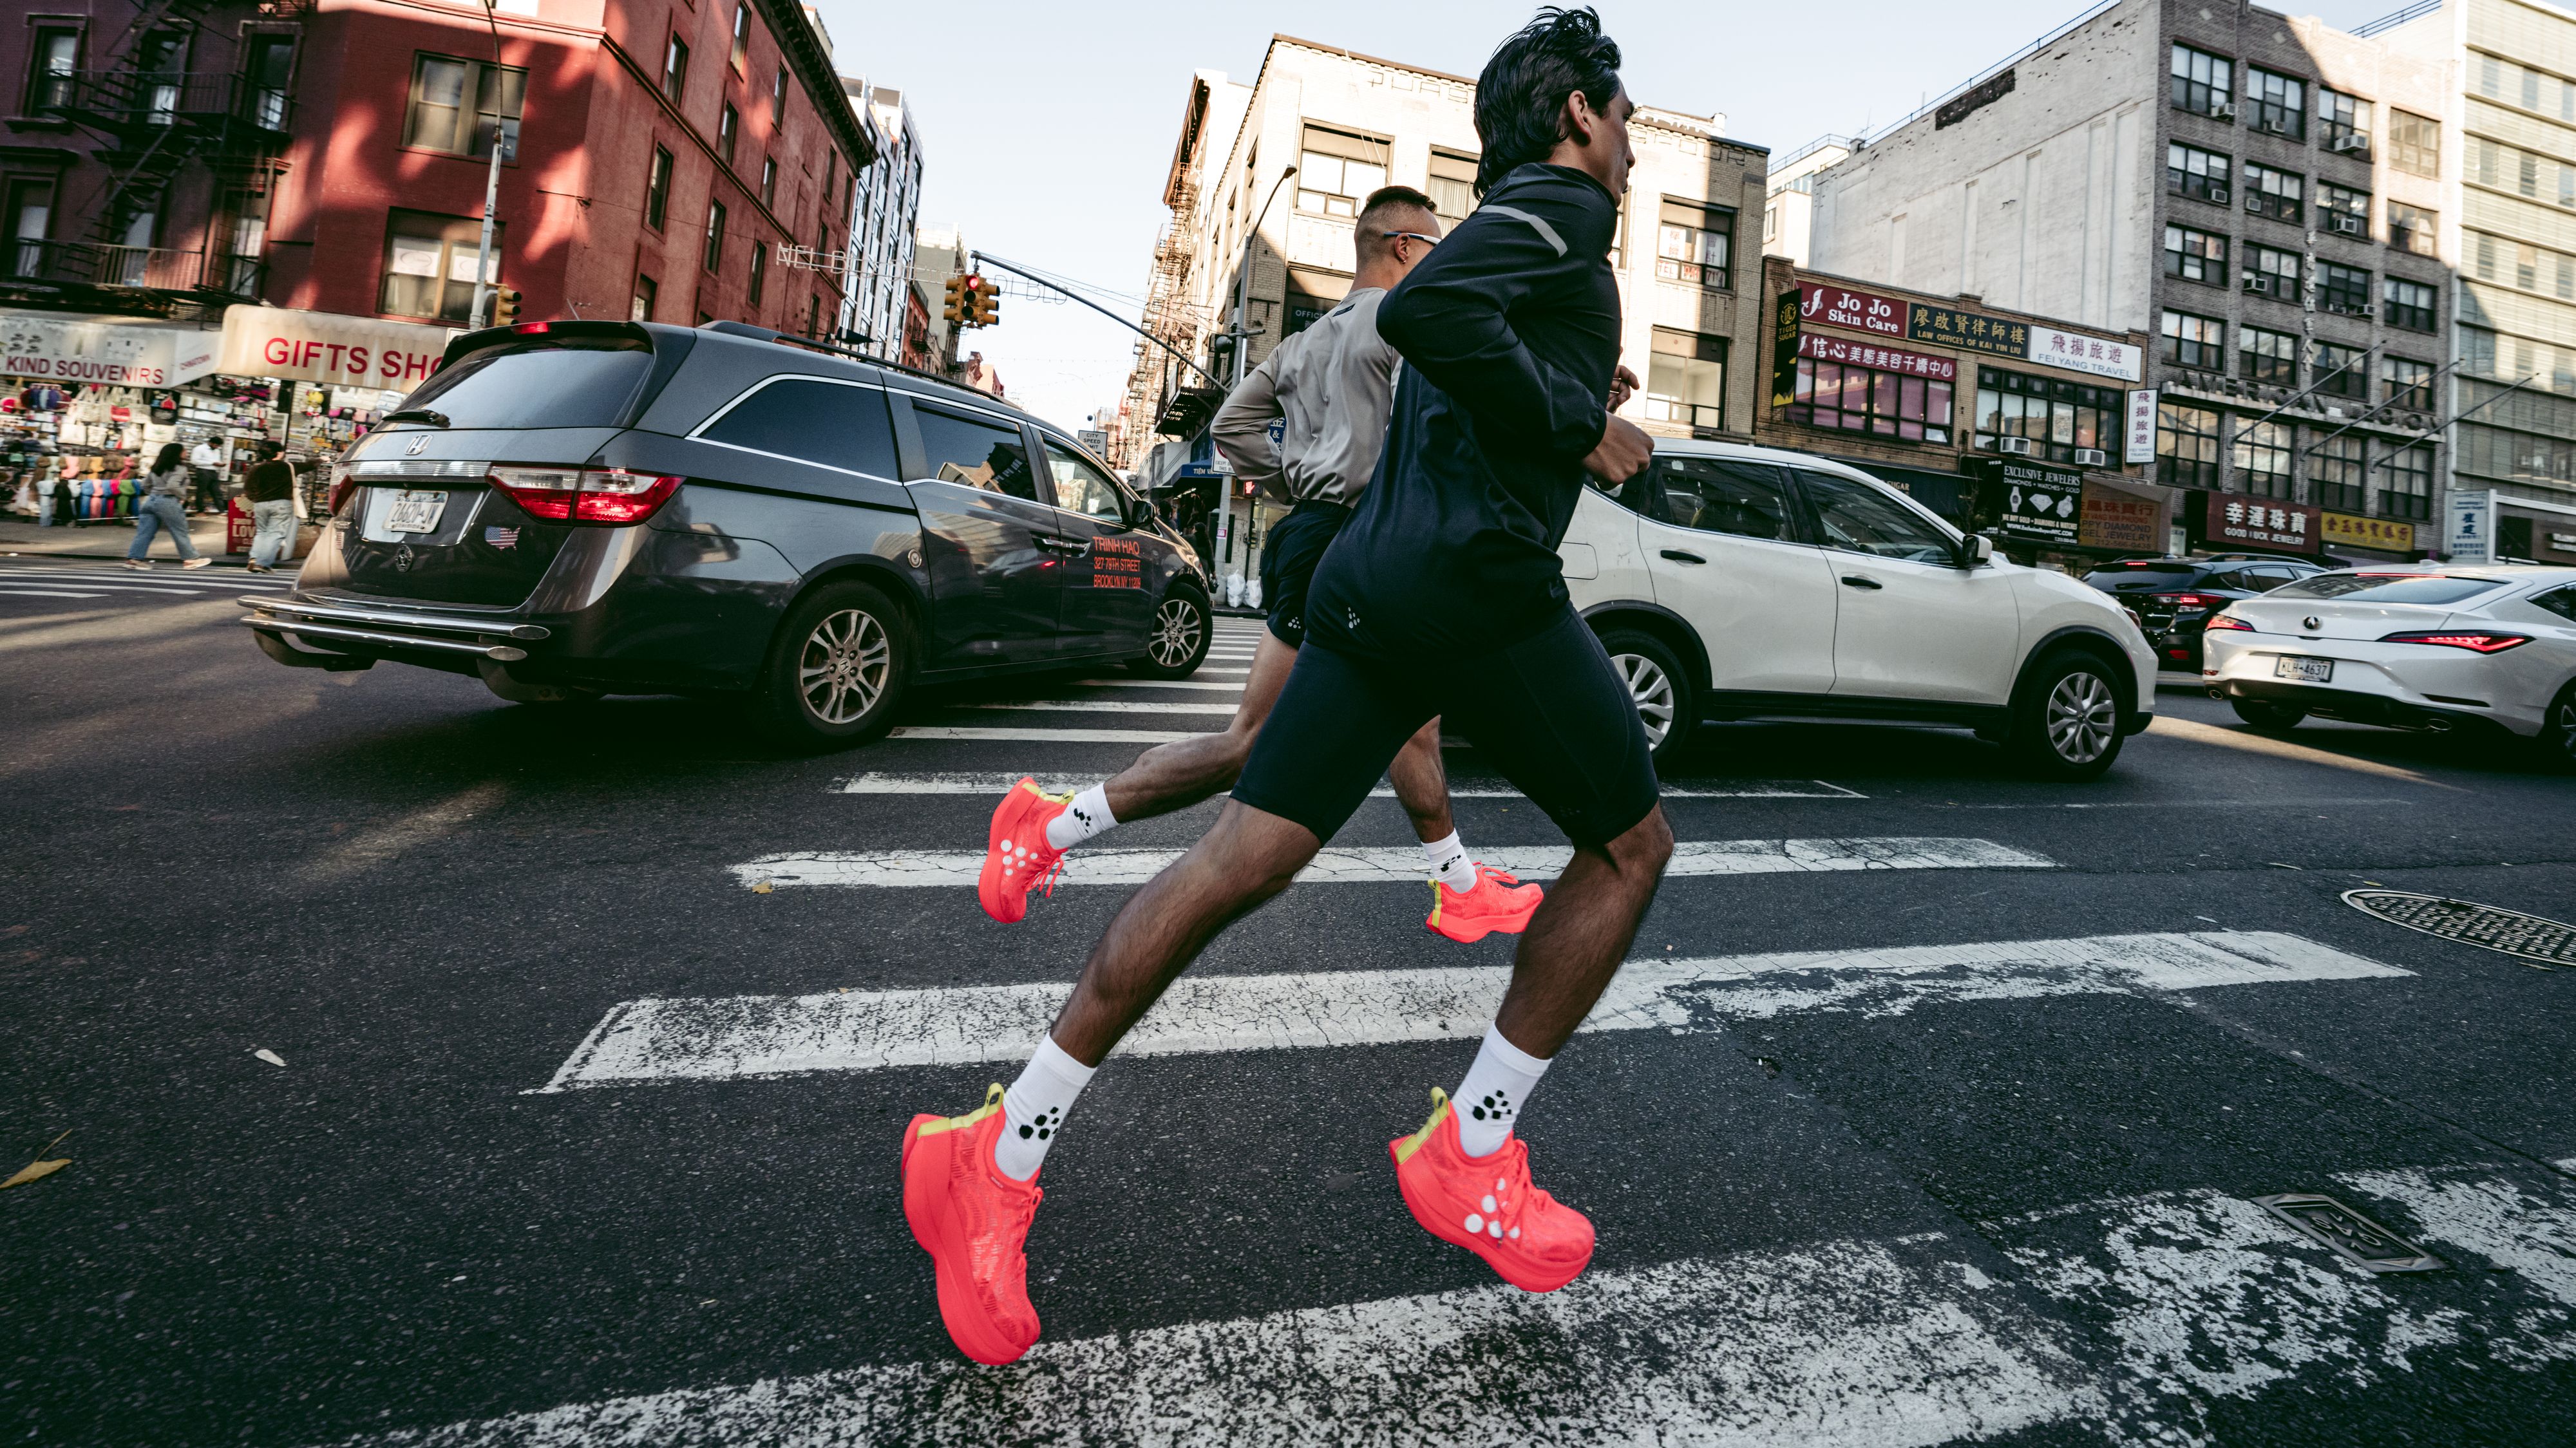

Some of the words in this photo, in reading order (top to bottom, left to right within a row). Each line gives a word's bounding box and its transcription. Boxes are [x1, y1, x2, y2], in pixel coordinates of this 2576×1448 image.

[776, 241, 819, 271] NEL
[1837, 293, 1861, 312] Jo
[1868, 299, 1891, 317] Jo
[1779, 324, 1797, 334] TIGER
[1828, 308, 1862, 326] Skin
[1866, 316, 1899, 333] Care
[1778, 330, 1797, 342] SUGAR
[1917, 330, 1933, 339] LAW
[1937, 334, 1964, 346] OFFICES
[1967, 339, 1977, 347] OF
[1979, 341, 1993, 350] KAI
[2010, 346, 2022, 355] LIU
[265, 337, 369, 374] GIFTS
[5, 356, 51, 375] KIND
[55, 359, 164, 384] SOUVENIRS
[2038, 353, 2056, 364] FEI
[2058, 357, 2088, 370] YANG
[2091, 363, 2132, 378] TRAVEL
[2003, 477, 2032, 487] DIAMONDS
[2038, 483, 2060, 491] WATCHES
[2004, 465, 2043, 480] EXCLUSIVE
[2045, 472, 2081, 486] JEWELERS
[232, 525, 256, 537] LOV
[2081, 529, 2101, 538] GEL
[2105, 531, 2152, 541] JEWELRY
[2104, 522, 2152, 533] DIAMOND
[2224, 527, 2247, 538] GOOD
[2271, 534, 2305, 545] JEWELRY
[1092, 536, 1121, 553] TRINH
[1122, 540, 1140, 555] HAO
[1094, 557, 1104, 570] 327
[1105, 558, 1119, 571] 79TH
[1120, 558, 1141, 572] STREET
[1094, 574, 1121, 588] BROOKLYN
[1121, 576, 1128, 588] NY
[2311, 1216, 2382, 1246] GAS
